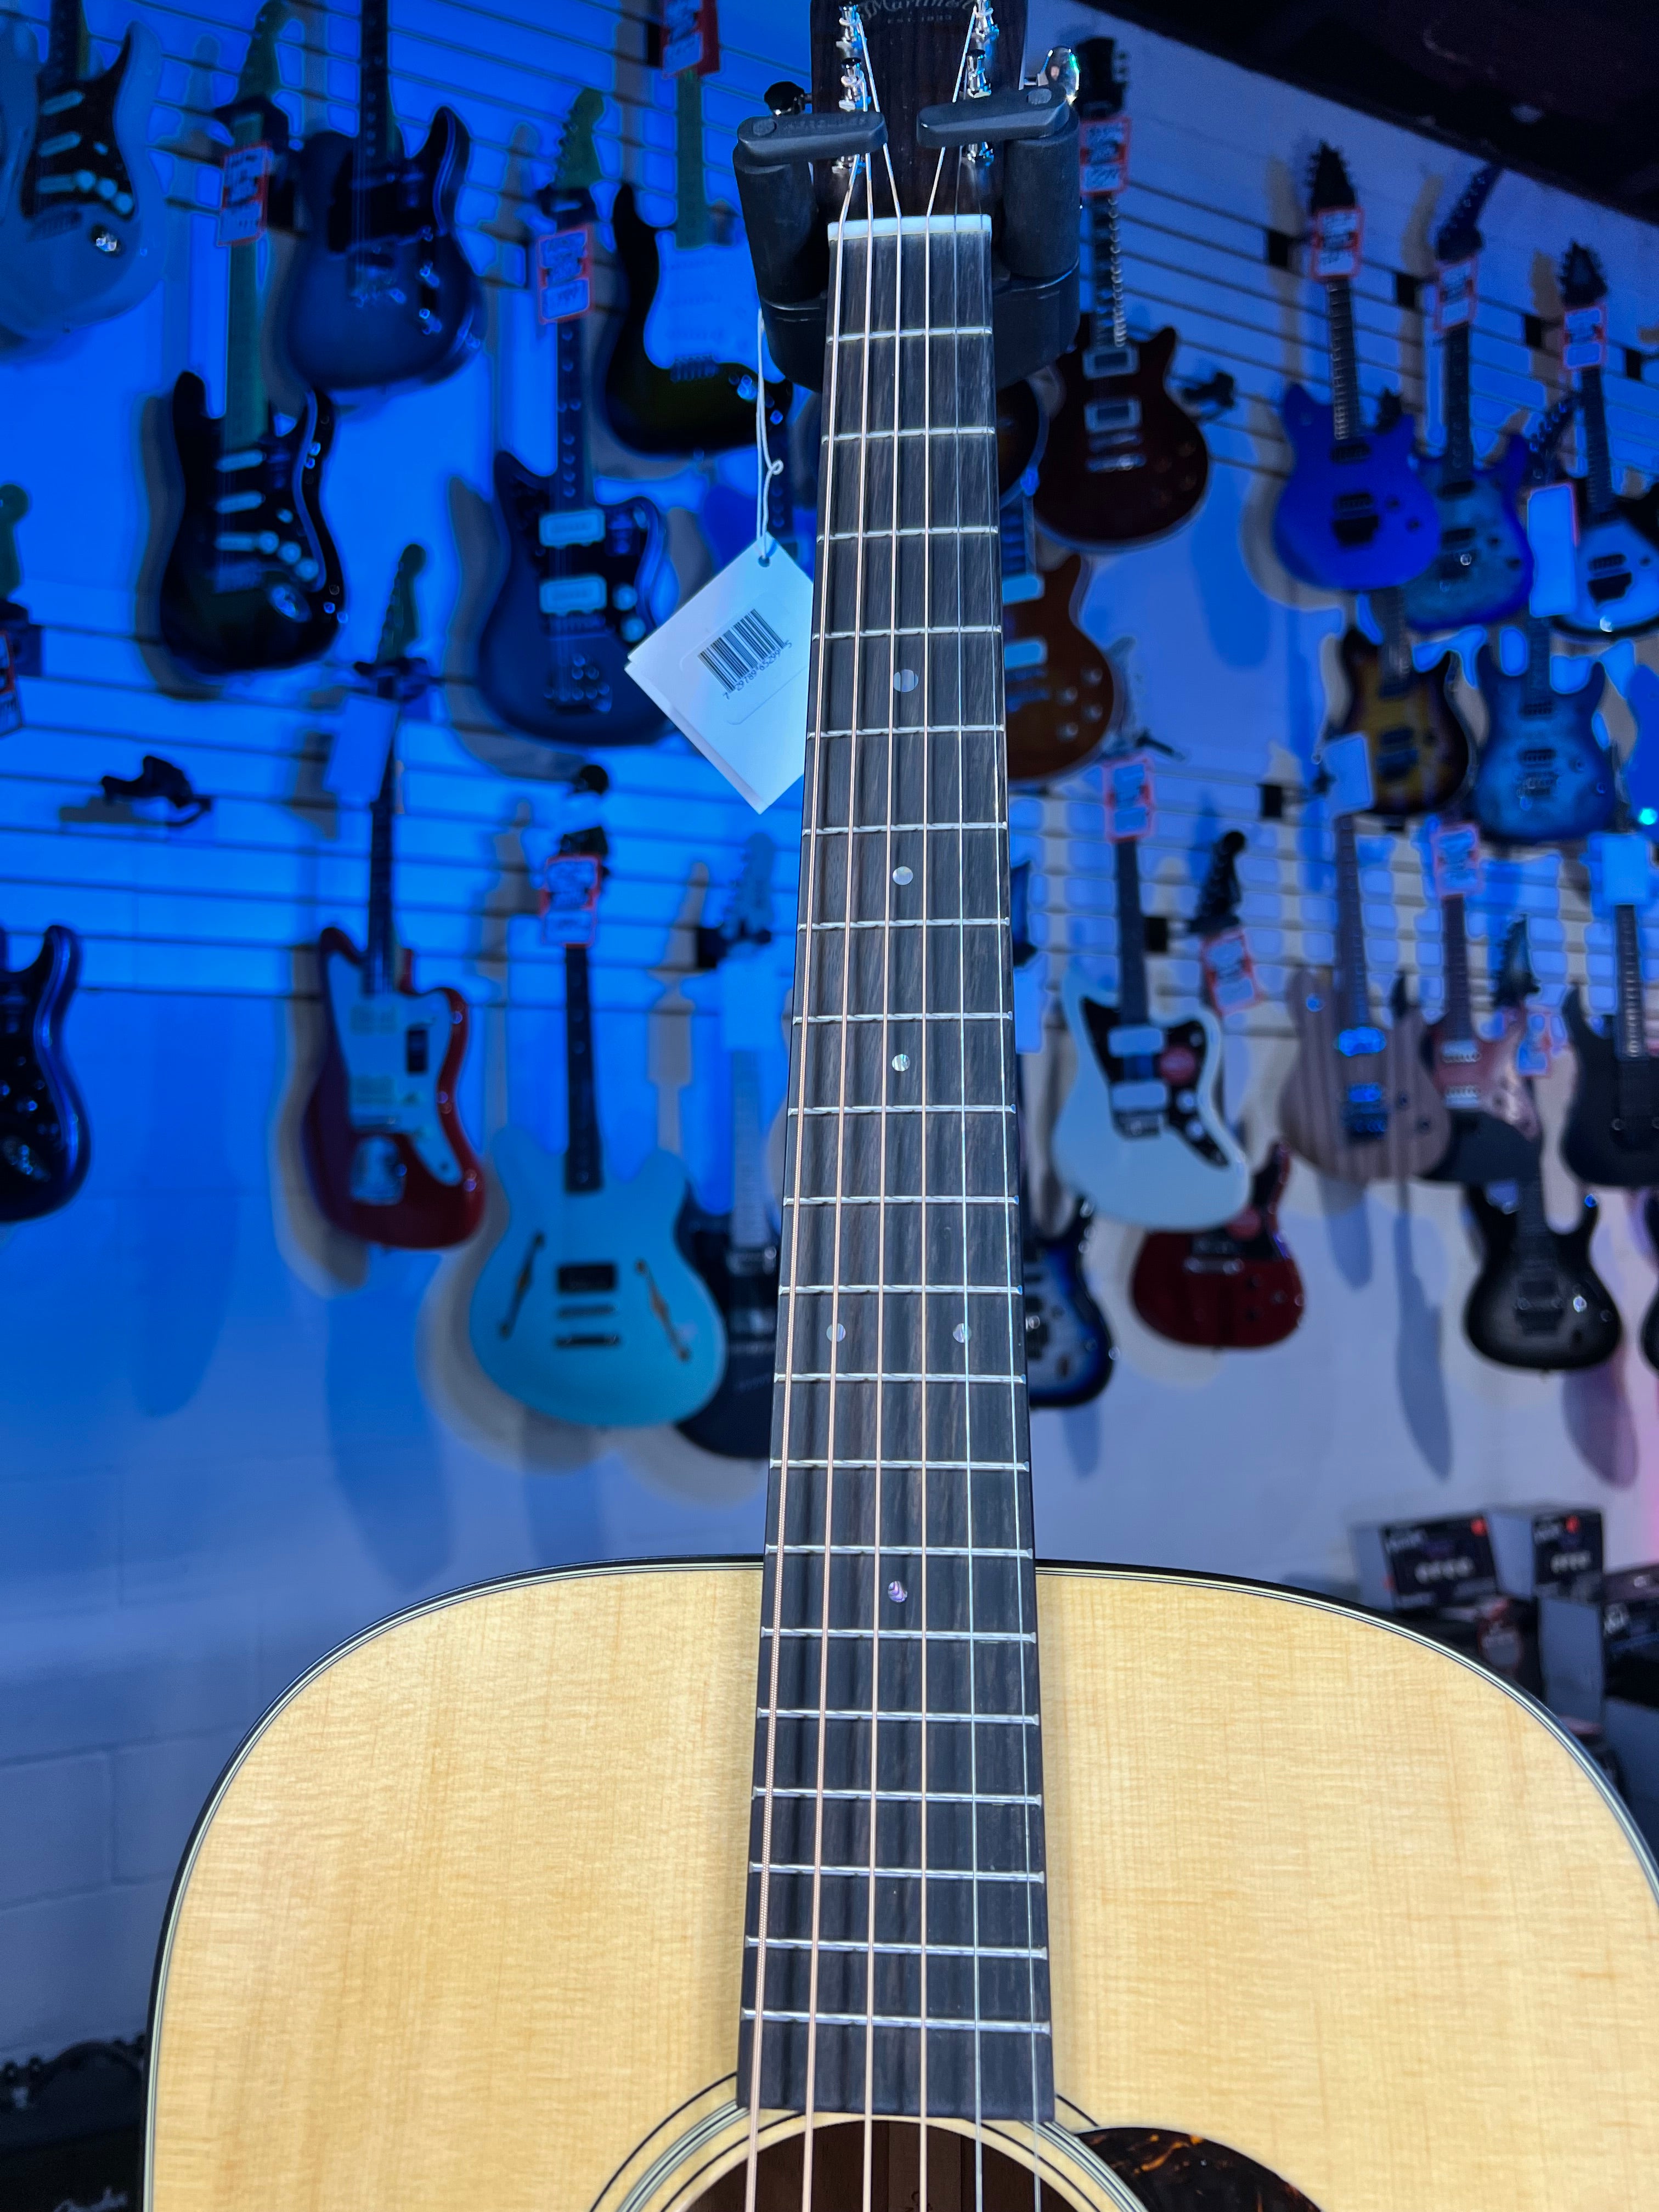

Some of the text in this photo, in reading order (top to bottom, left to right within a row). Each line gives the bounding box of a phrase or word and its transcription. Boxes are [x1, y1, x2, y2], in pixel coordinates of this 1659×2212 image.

[723, 640, 792, 700] 7 29789 65299 5
